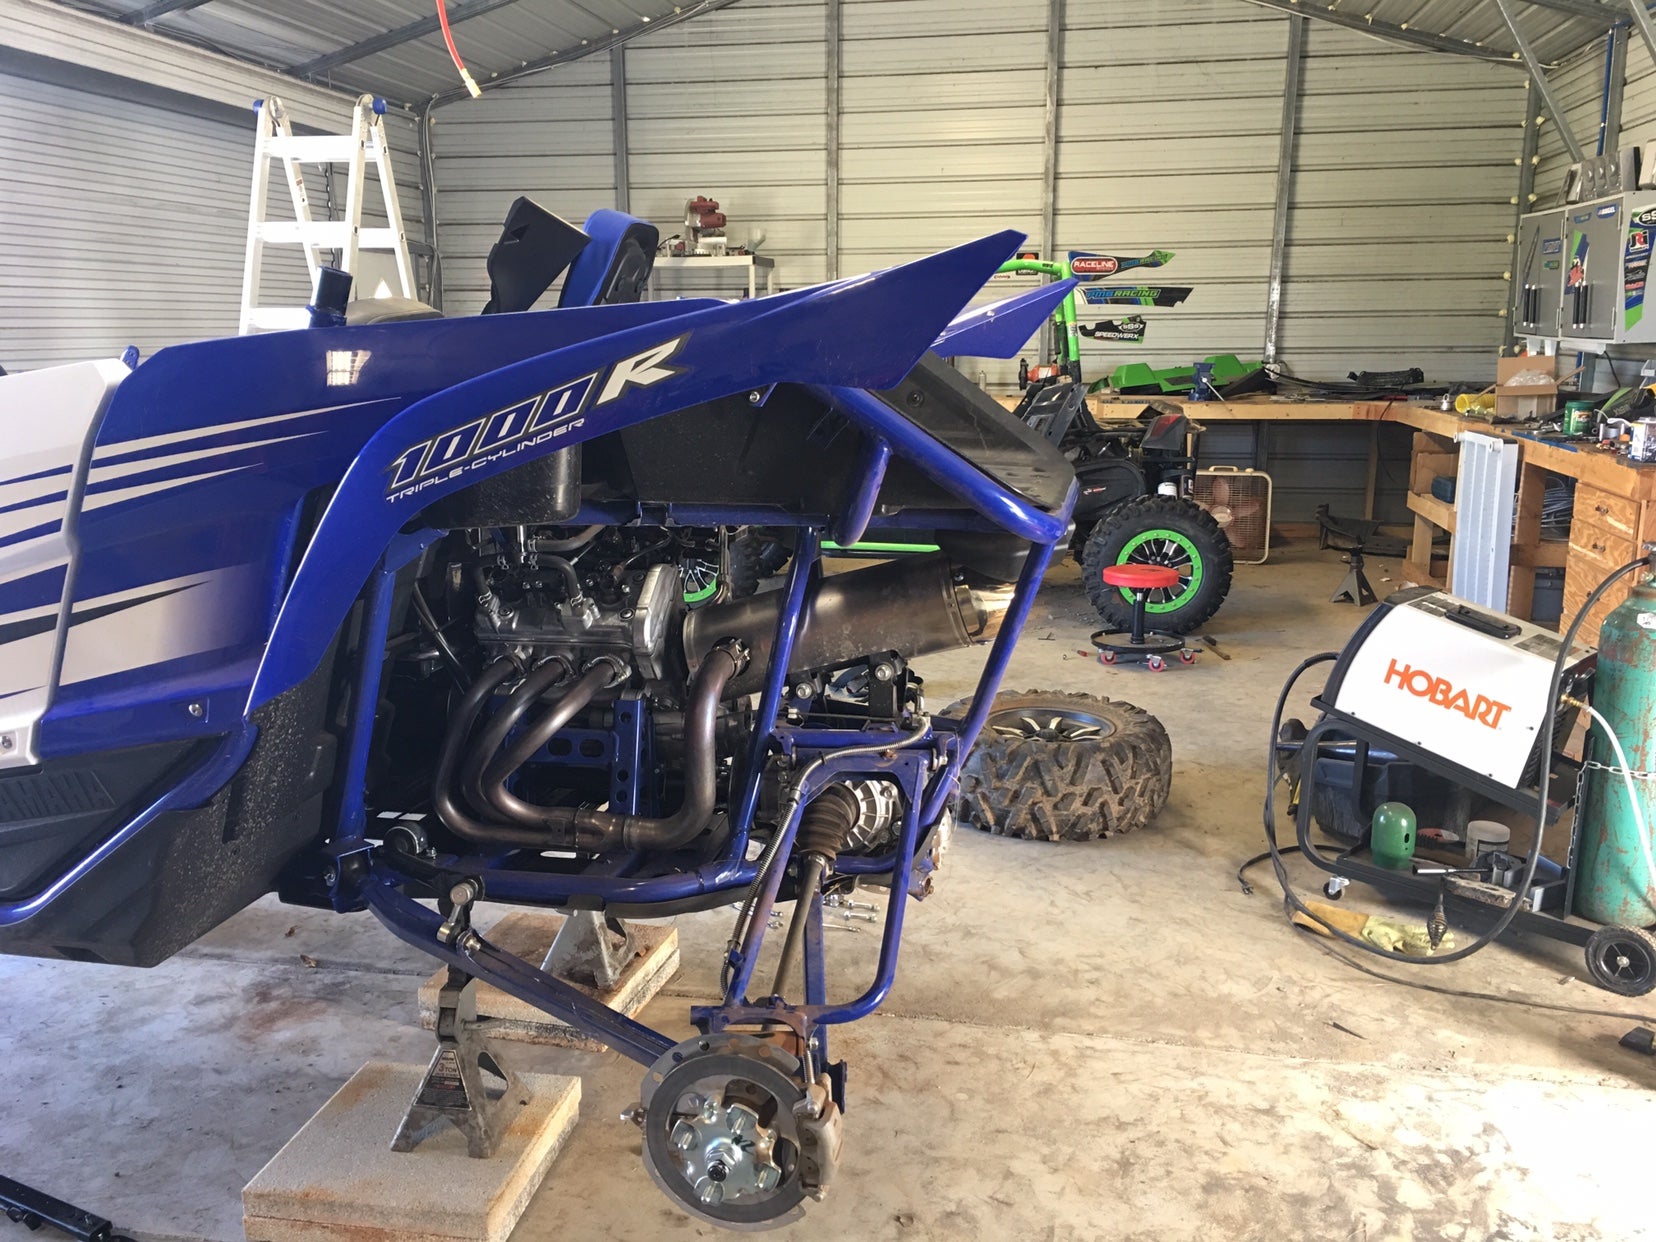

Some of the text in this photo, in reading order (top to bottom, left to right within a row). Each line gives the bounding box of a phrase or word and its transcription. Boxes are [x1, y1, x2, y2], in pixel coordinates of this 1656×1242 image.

[1073, 260, 1114, 268] RACELINE
[1114, 290, 1157, 298] RACING
[1094, 331, 1139, 339] SPEEDWERX
[386, 417, 585, 504] TRIPLE-CYLINDER
[1384, 658, 1512, 730] HOBART
